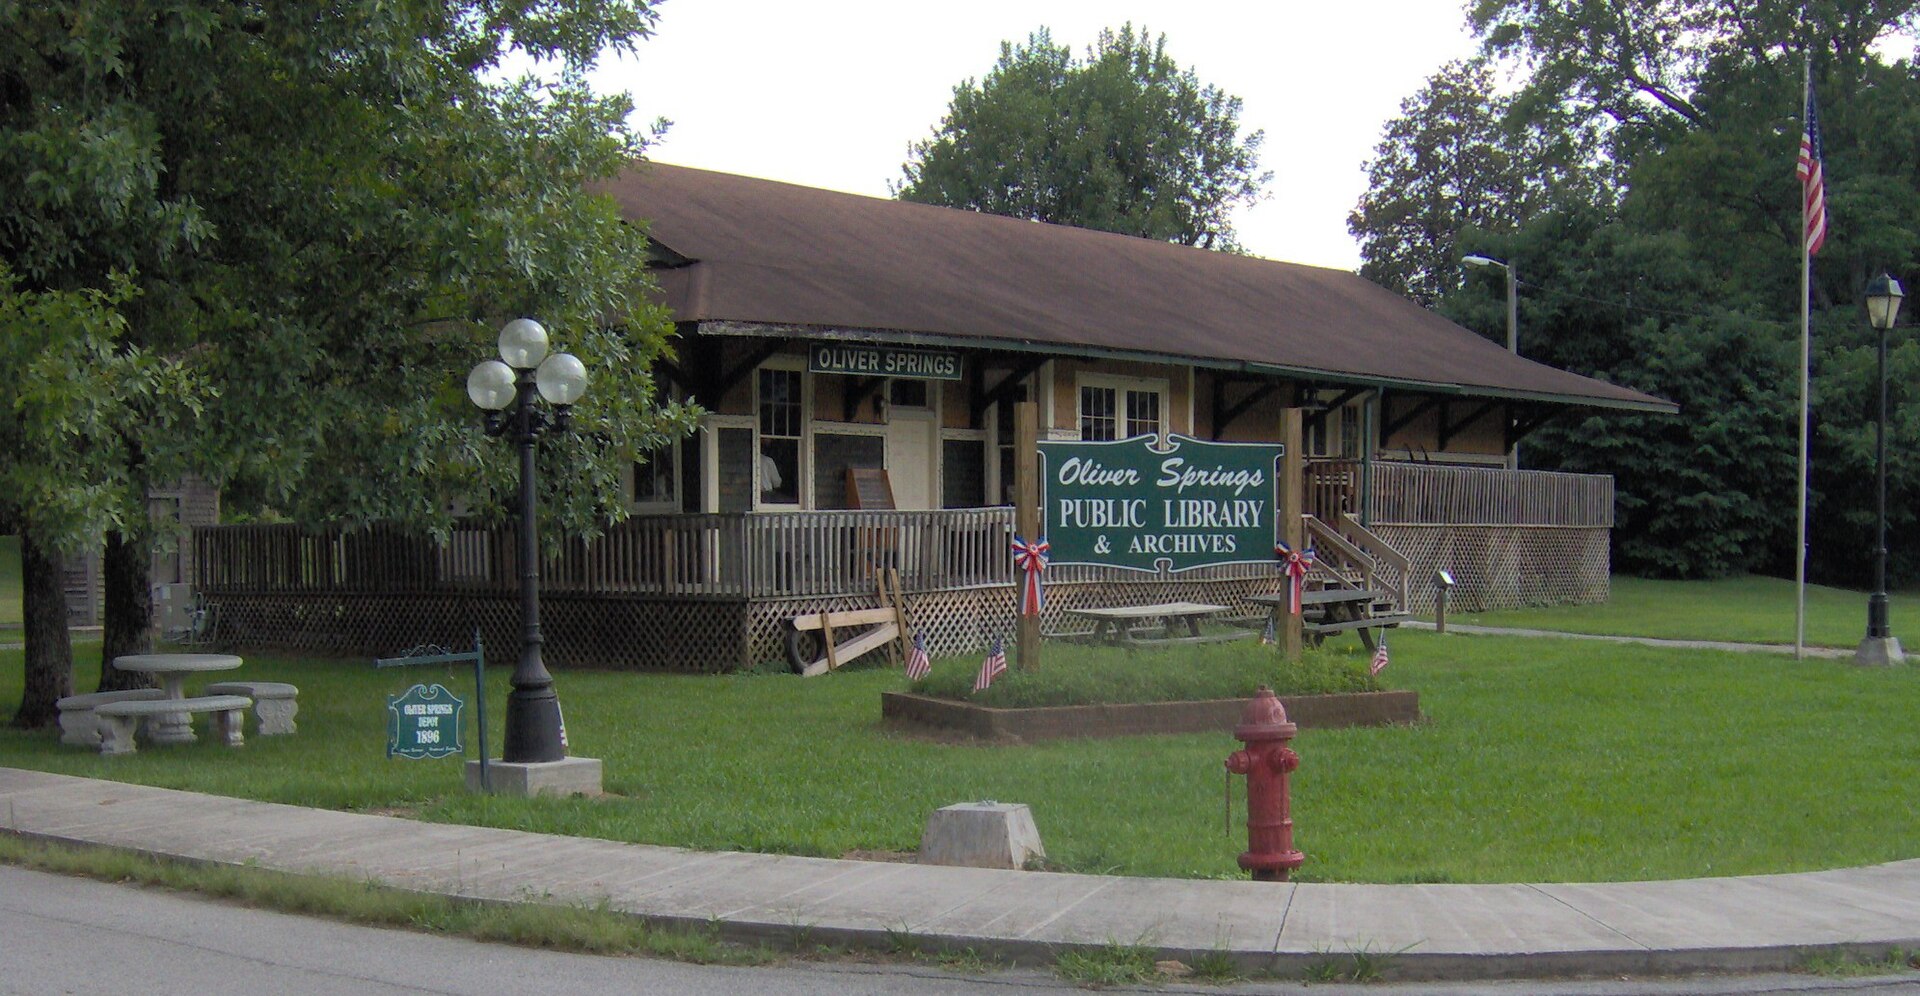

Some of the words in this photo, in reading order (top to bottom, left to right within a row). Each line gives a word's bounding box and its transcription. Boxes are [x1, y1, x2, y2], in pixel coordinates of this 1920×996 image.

[819, 348, 879, 371] OLIVER
[885, 352, 955, 375] SPRINGS
[1058, 456, 1141, 486] Oliver
[1156, 457, 1265, 496] Springs
[1059, 499, 1147, 528] PUBLIC
[1164, 499, 1265, 528] LIBRARY
[1093, 534, 1112, 555] &
[1128, 534, 1237, 554] ARCHIVES
[427, 703, 453, 715] SPRINGS
[418, 716, 439, 728] DEPOT
[416, 729, 440, 744] 1896
